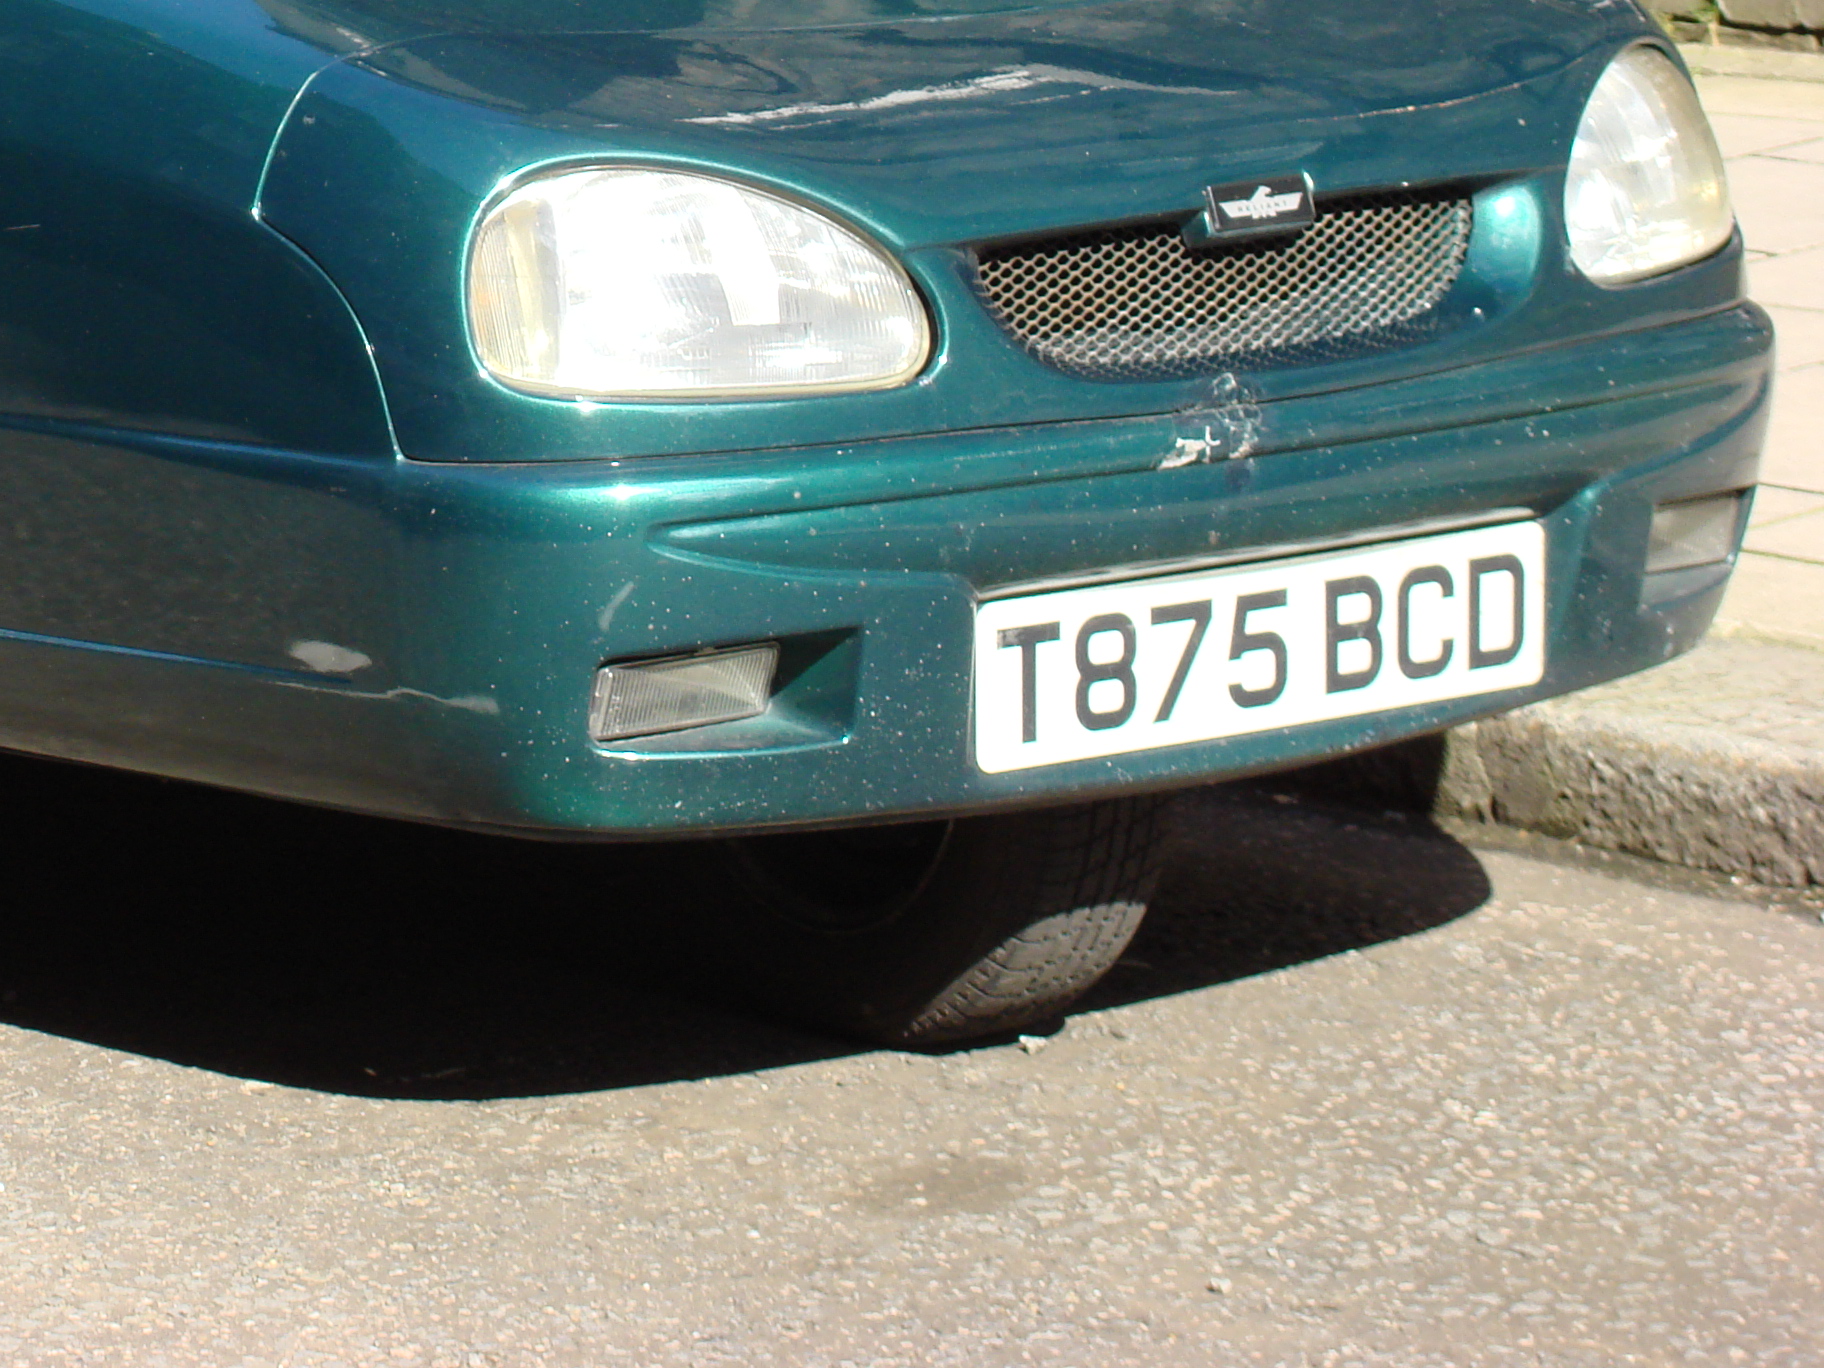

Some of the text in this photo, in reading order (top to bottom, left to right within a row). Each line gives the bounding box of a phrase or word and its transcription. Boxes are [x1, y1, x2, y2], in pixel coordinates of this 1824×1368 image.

[1237, 200, 1287, 212] RELIANT
[996, 554, 1524, 743] T875 BCD
